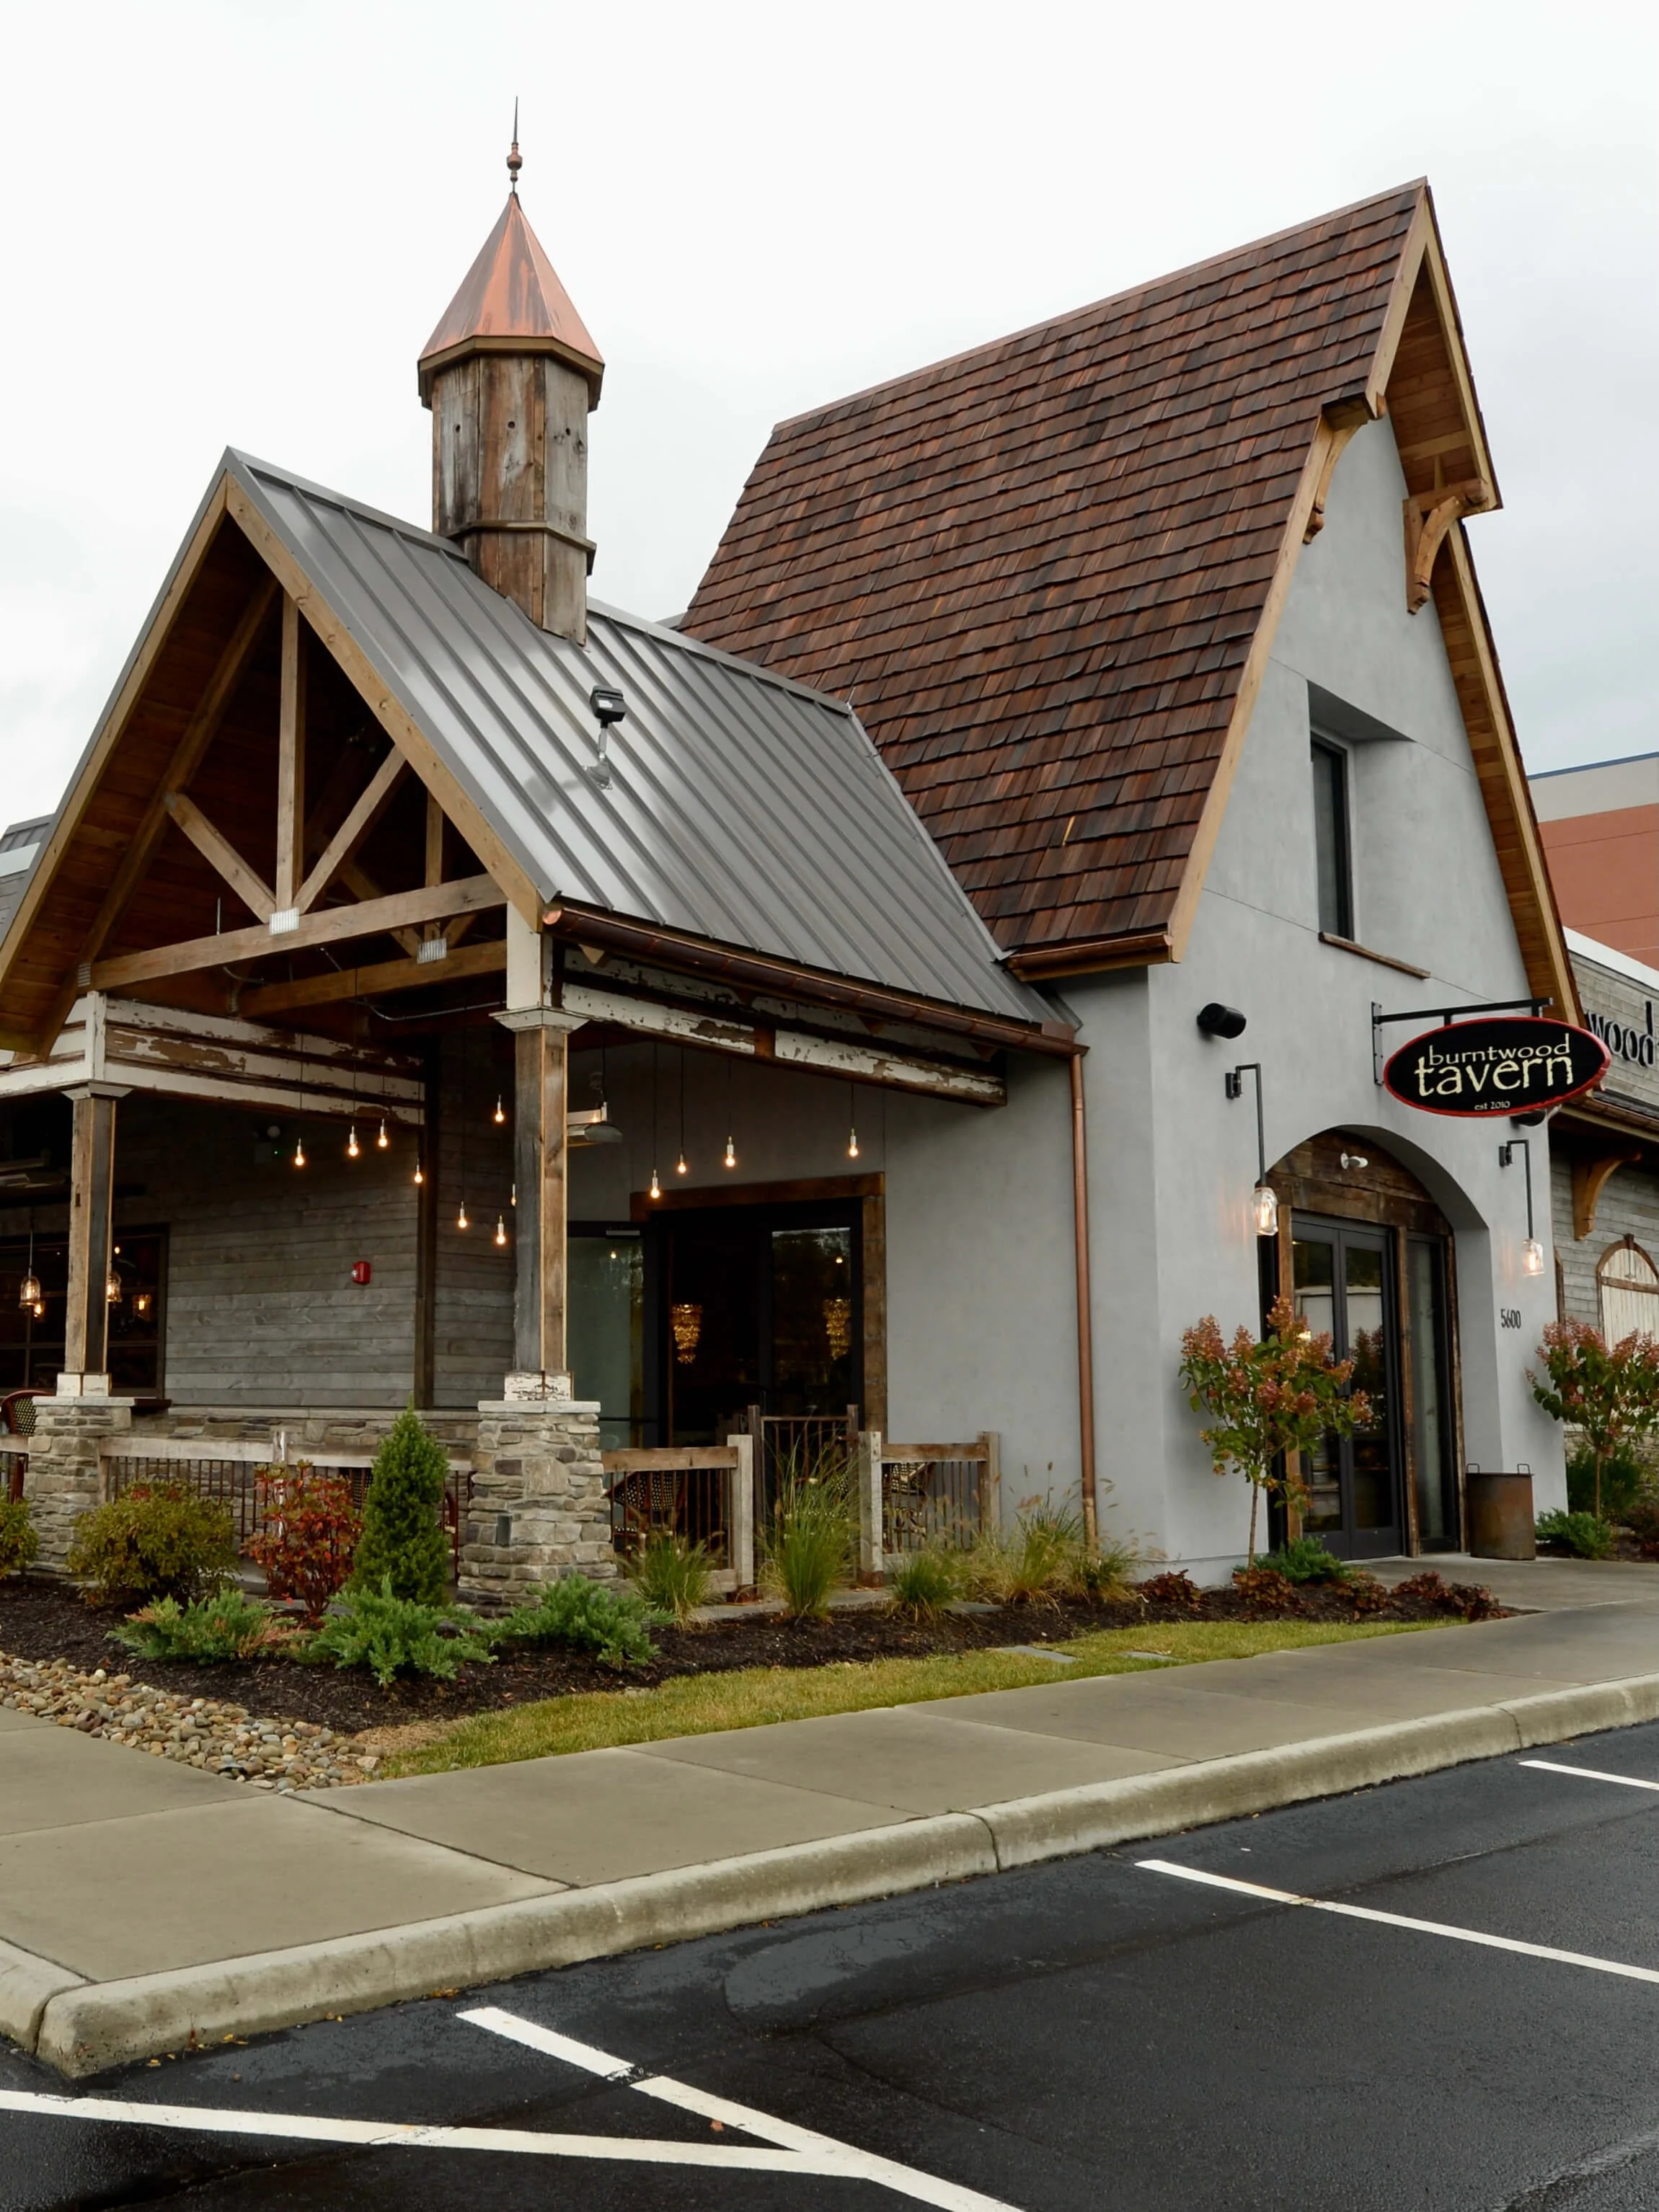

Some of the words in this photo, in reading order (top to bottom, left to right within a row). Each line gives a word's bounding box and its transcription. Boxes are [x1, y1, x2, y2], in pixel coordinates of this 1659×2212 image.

[1428, 1032, 1570, 1066] burntwood
[1414, 1056, 1573, 1097] tavern
[1474, 1102, 1487, 1110] est
[1490, 1100, 1510, 1110] 2010
[1500, 1309, 1521, 1329] 5600
